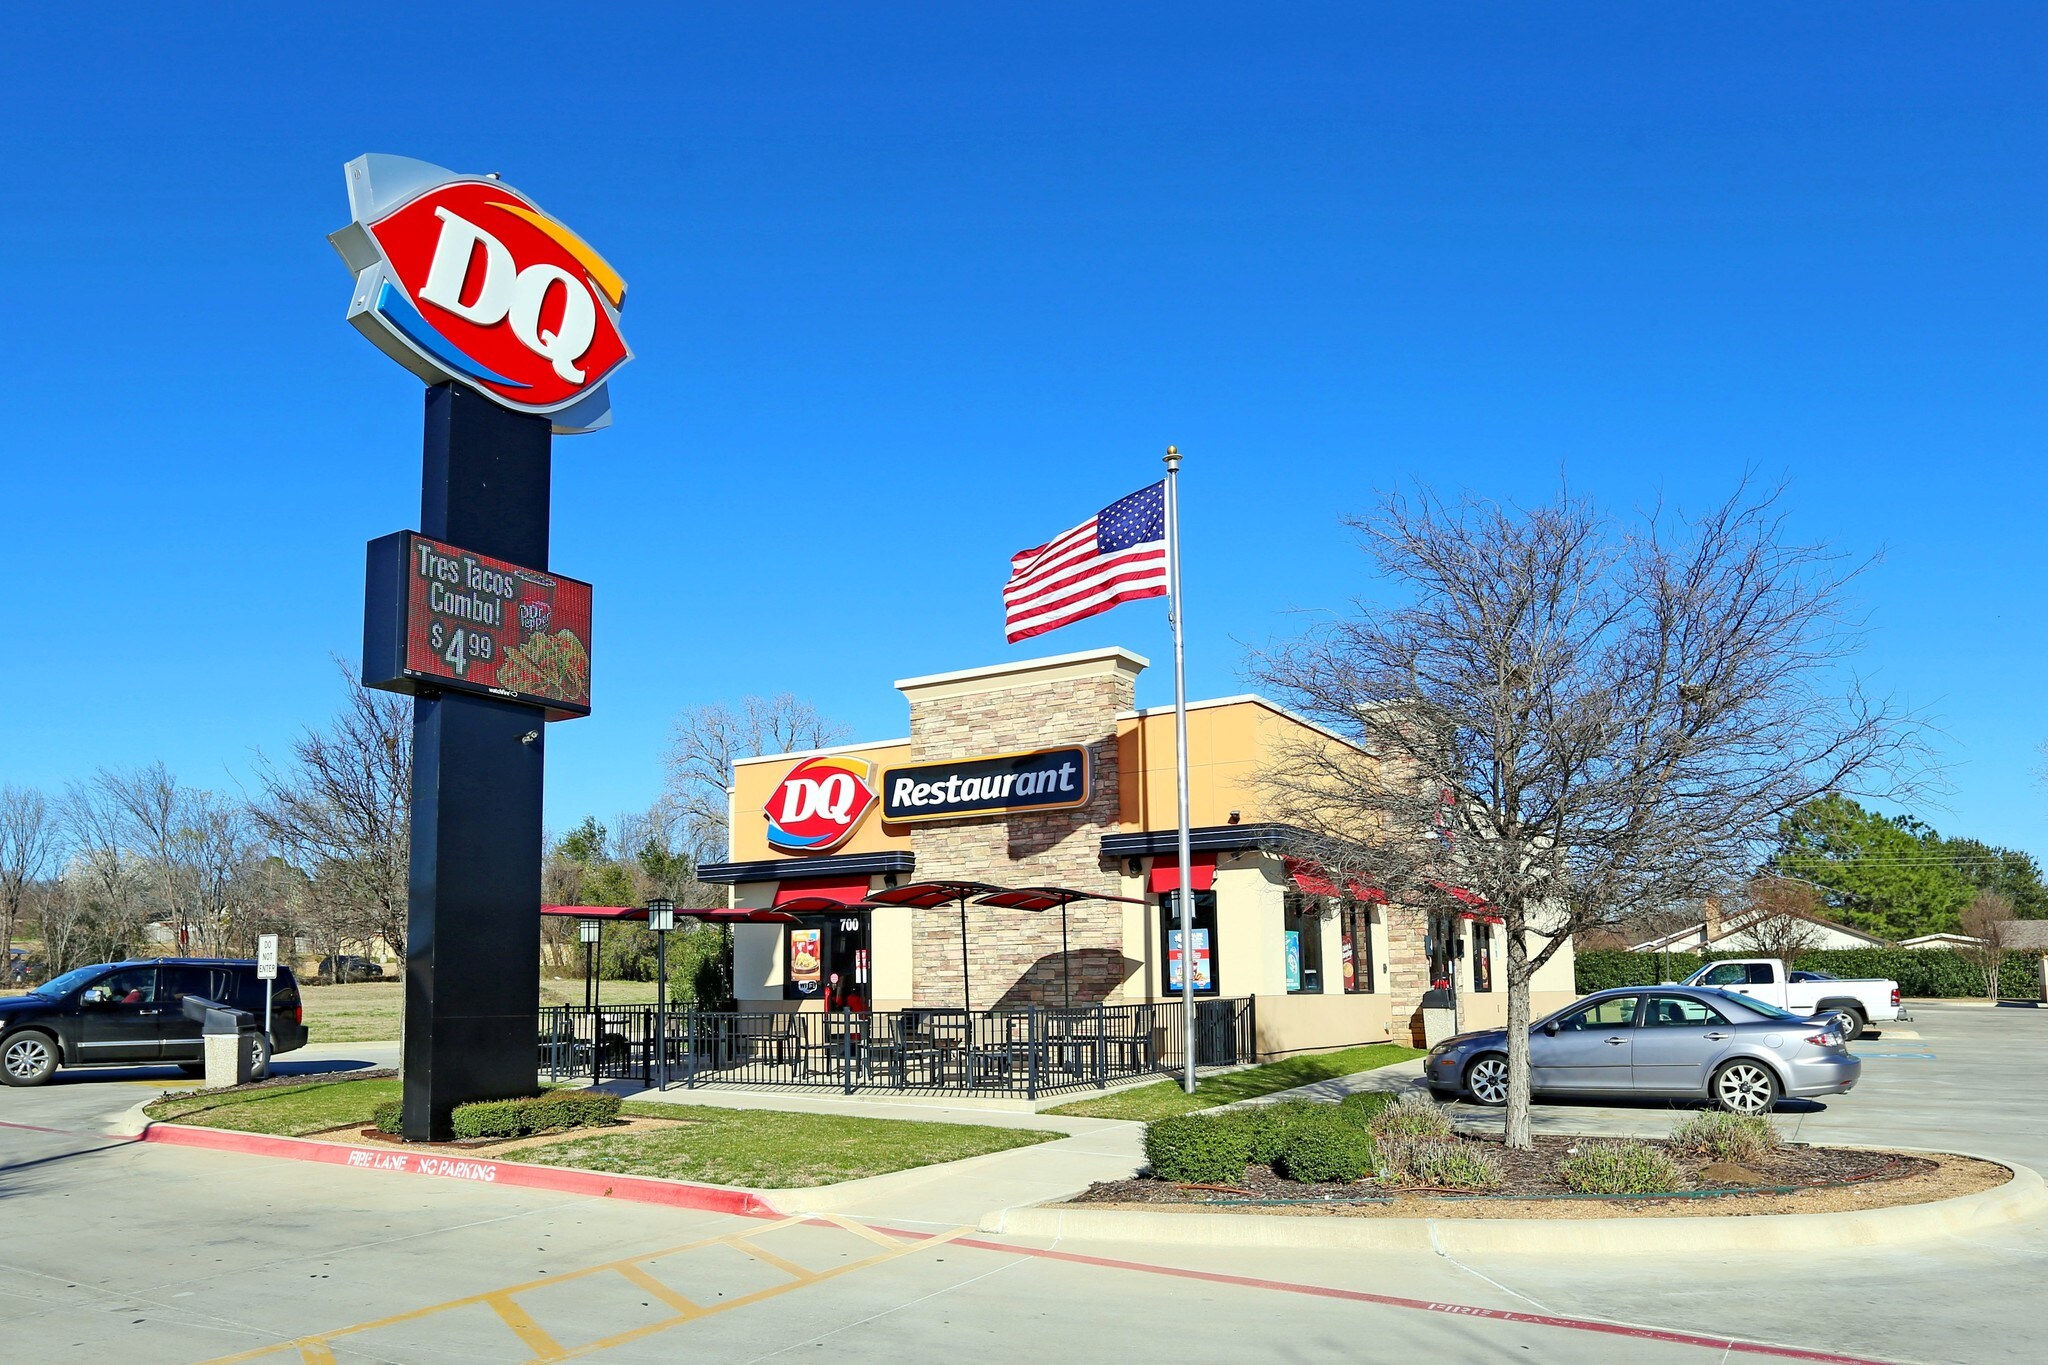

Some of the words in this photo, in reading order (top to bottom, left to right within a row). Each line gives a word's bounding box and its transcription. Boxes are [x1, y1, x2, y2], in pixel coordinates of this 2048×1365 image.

[418, 205, 596, 384] DQ
[417, 543, 460, 584] Tres
[463, 556, 514, 599] Tacos
[431, 581, 501, 627] Combo!
[779, 773, 856, 825] DQ
[891, 761, 1077, 808] Restaurant
[839, 918, 859, 932] 700
[262, 952, 273, 961] NOT
[264, 940, 272, 949] DO
[259, 964, 275, 973] ENTER
[347, 1150, 374, 1167] FIRE
[374, 1153, 408, 1171] LANE
[417, 1158, 438, 1175] NO
[438, 1160, 496, 1182] PARKING
[1427, 1302, 1493, 1318] FIRE
